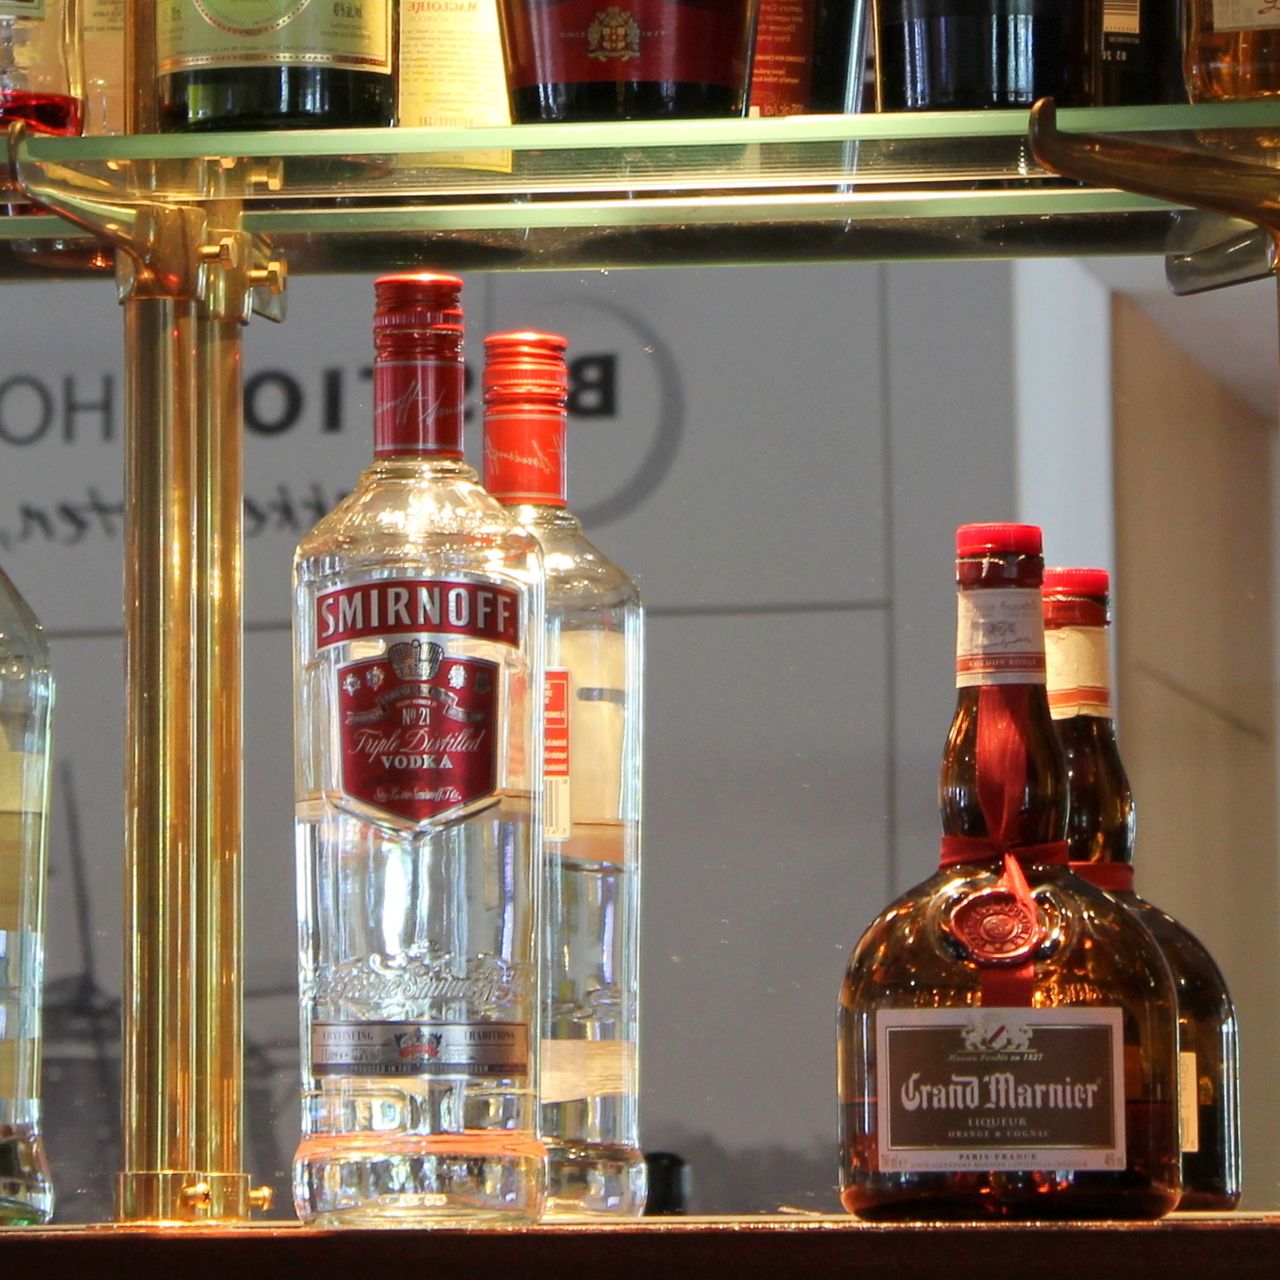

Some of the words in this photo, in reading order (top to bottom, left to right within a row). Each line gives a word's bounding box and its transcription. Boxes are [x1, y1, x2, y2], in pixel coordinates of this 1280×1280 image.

[321, 586, 512, 639] SMIRNOFF
[418, 706, 431, 725] 21
[348, 728, 400, 763] Triple
[399, 725, 486, 753] Distilled
[381, 755, 453, 769] VODKA
[1023, 1052, 1044, 1062] 1827
[900, 1072, 982, 1112] Grand
[982, 1072, 1099, 1110] Marnier
[968, 1117, 1028, 1128] LIQUEUR
[948, 1130, 991, 1139] ORANGE
[1006, 1129, 1050, 1138] COGNAC
[958, 1153, 991, 1161] PARIS
[993, 1152, 1039, 1161] FRANCE
